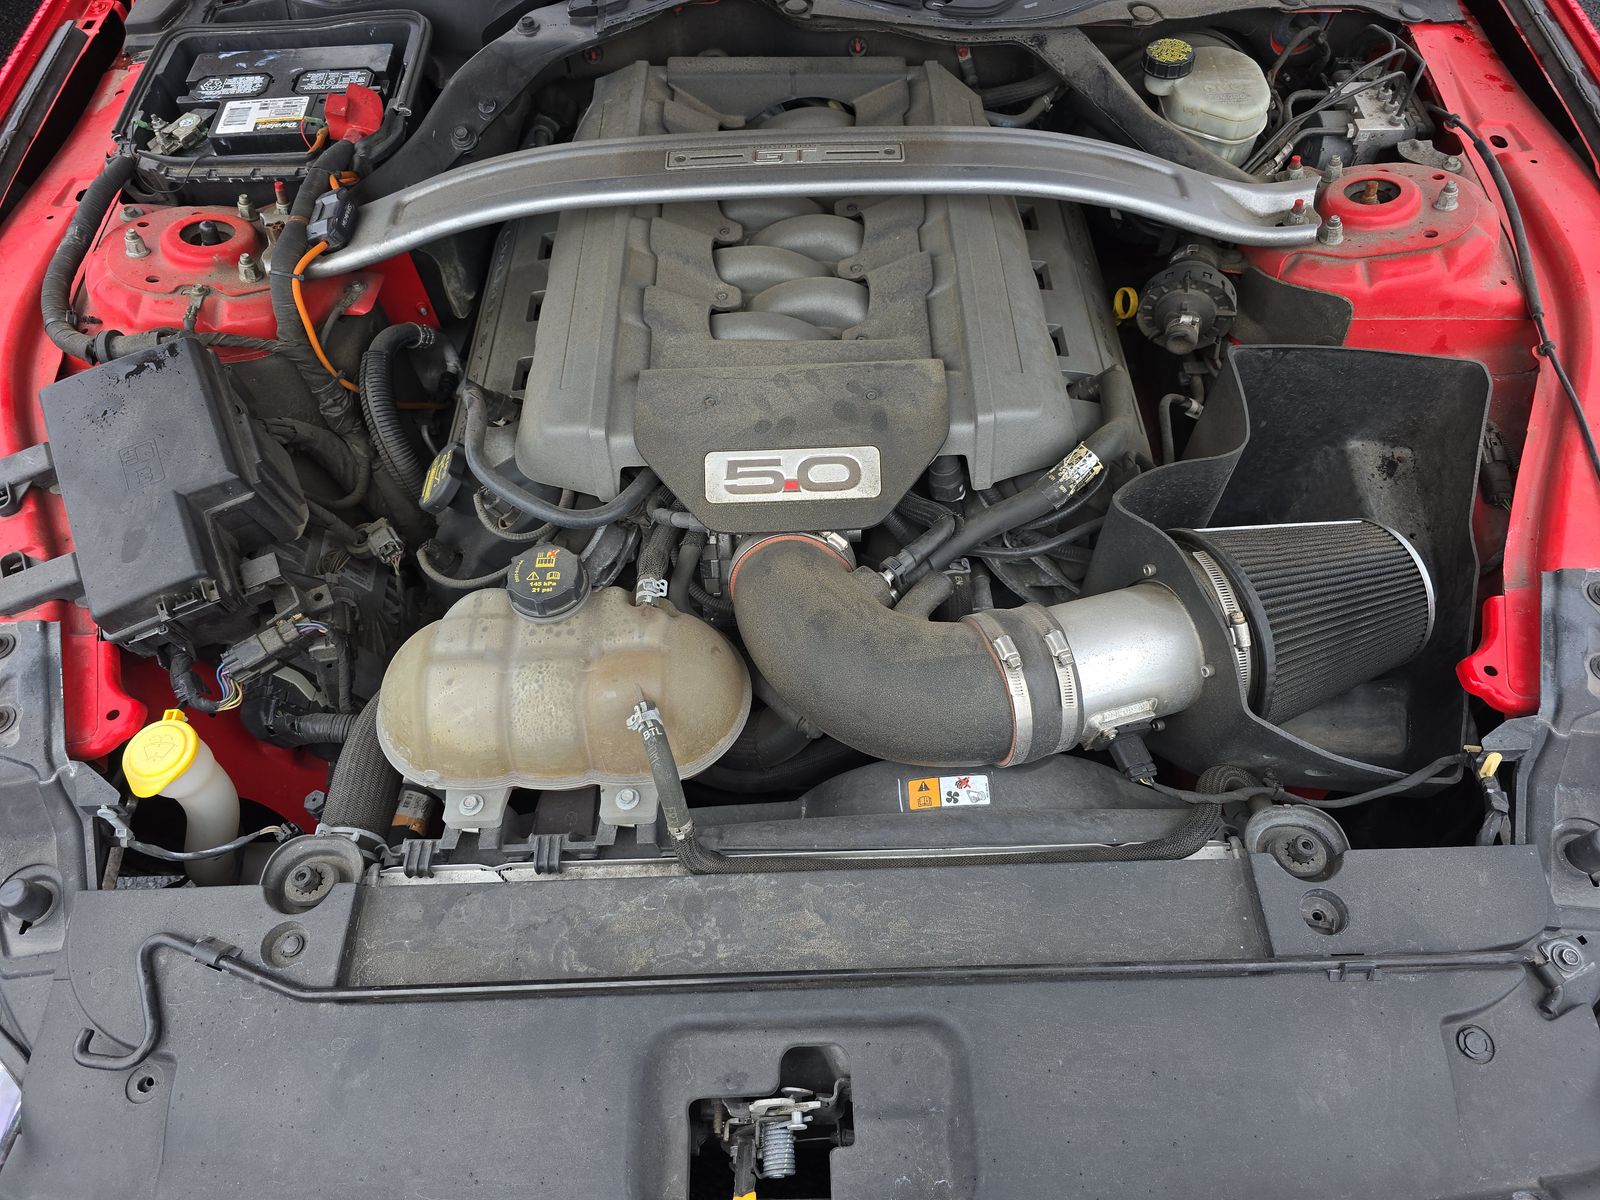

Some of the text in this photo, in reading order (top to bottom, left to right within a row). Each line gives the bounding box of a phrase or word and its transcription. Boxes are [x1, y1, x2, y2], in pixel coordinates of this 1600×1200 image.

[257, 122, 298, 130] Duralast
[752, 149, 817, 164] GT
[724, 455, 861, 495] 5.0
[643, 727, 663, 741] BTL
